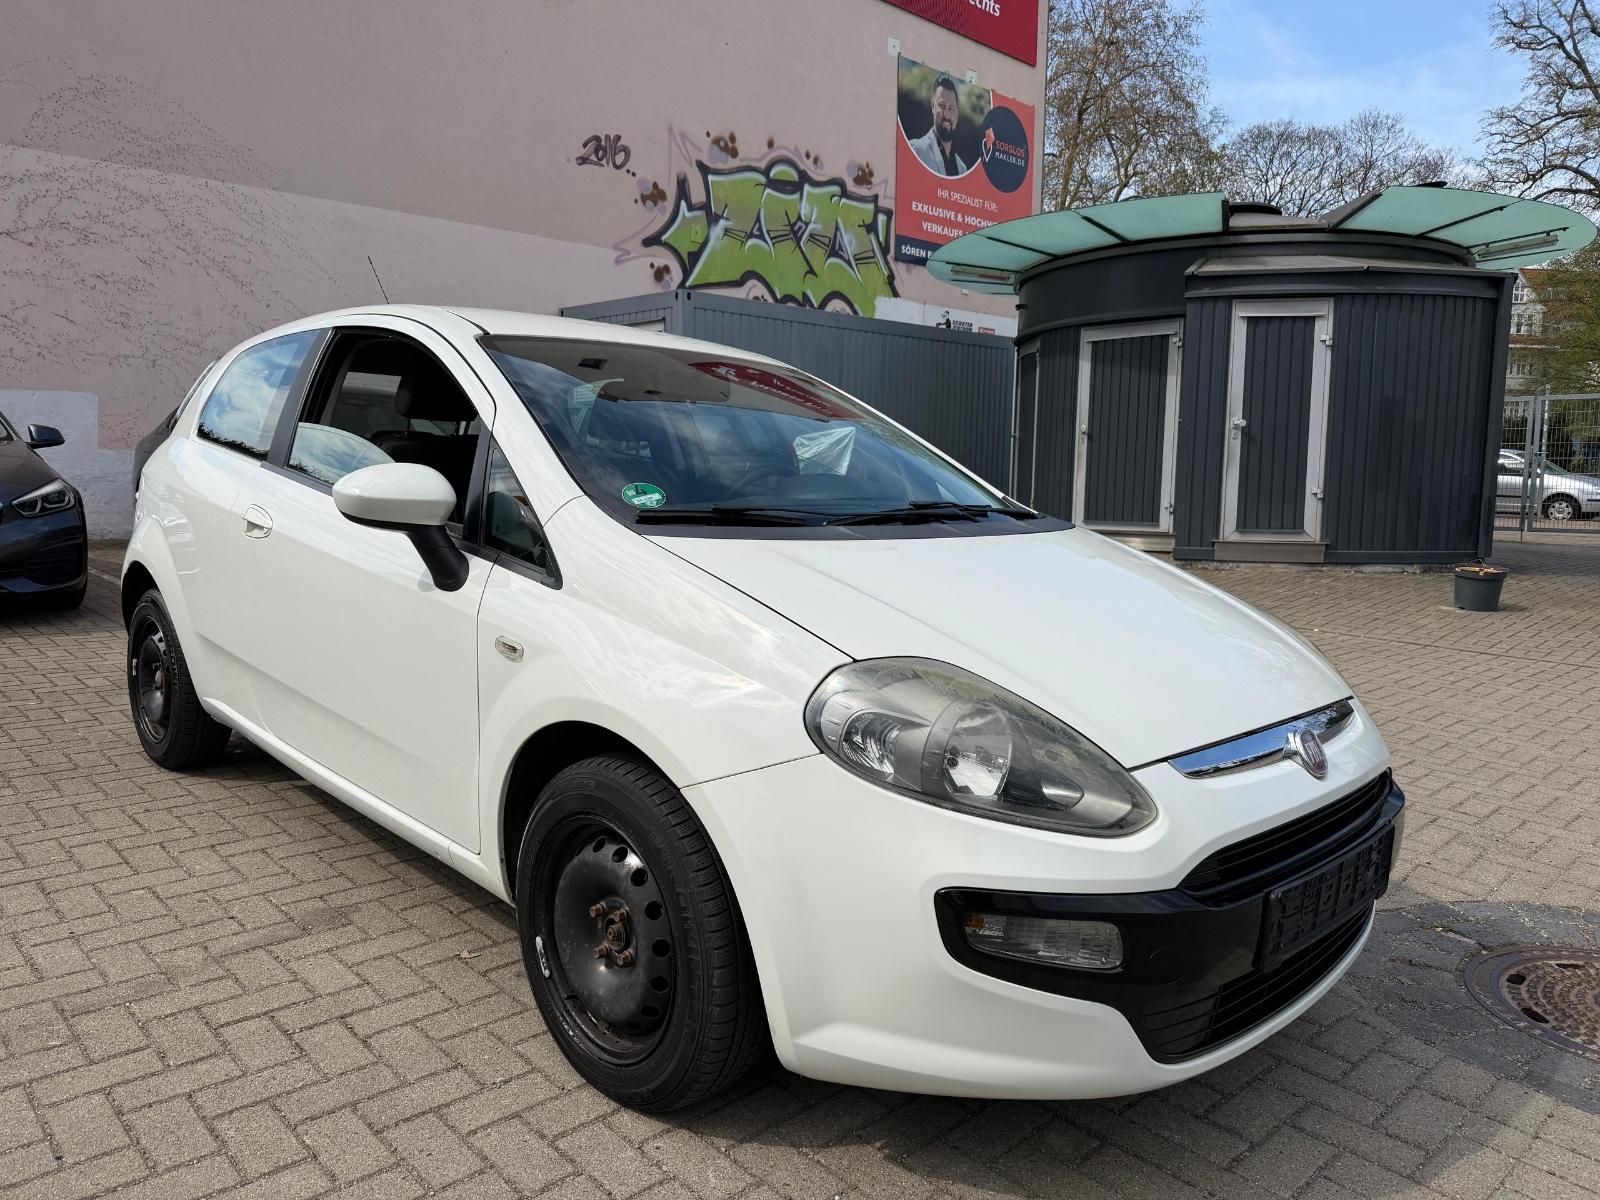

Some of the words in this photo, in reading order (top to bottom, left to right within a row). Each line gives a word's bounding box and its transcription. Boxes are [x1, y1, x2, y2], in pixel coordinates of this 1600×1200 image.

[575, 133, 631, 170] 2016
[995, 140, 1025, 158] SORGLOS
[995, 151, 1025, 167] MAKLER.DE
[937, 188, 950, 200] IHR
[950, 191, 983, 208] SPEZIALIST
[984, 200, 998, 213] FÜR:
[911, 201, 956, 221] EXKLUSIVE
[957, 213, 963, 223] &
[964, 215, 998, 228] HOCHW
[901, 244, 926, 258] SÖREN
